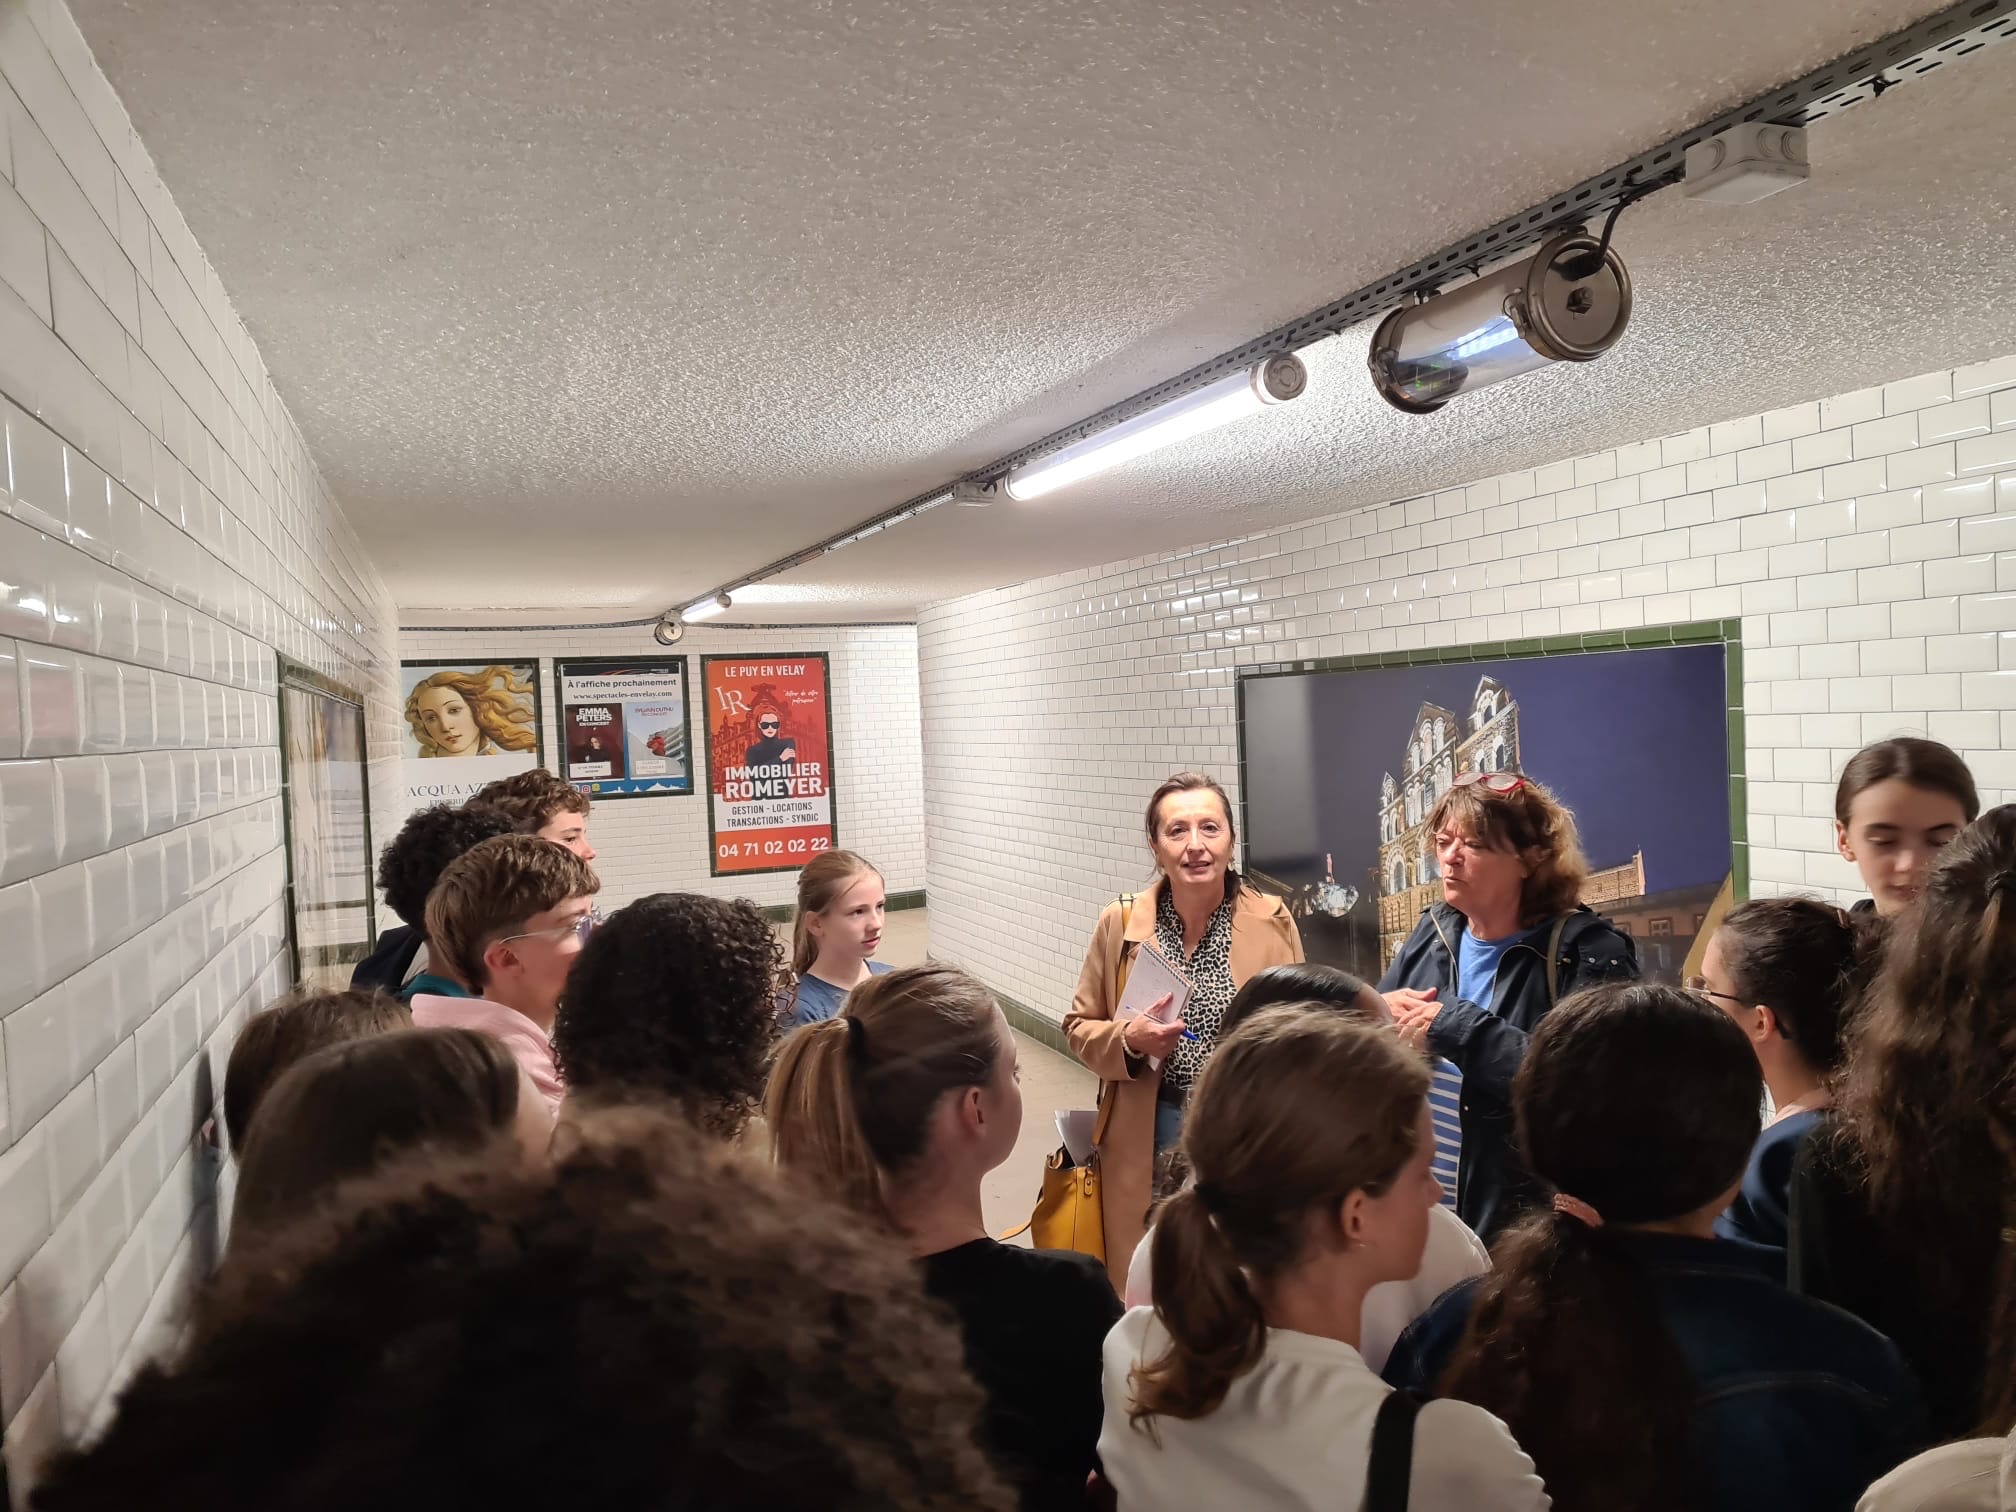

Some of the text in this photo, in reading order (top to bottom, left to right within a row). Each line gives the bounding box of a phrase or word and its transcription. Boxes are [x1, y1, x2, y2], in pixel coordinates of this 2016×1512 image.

[725, 665, 805, 677] LE PUY EN VELAY
[567, 679, 677, 688] À l'affiche prochainement
[576, 713, 612, 722] PETERS
[578, 707, 609, 715] EMMA
[725, 762, 821, 780] IMMOBILIER
[407, 784, 460, 798] ACQUA
[725, 777, 822, 799] ROMEYER
[732, 804, 764, 815] GESTION
[772, 802, 813, 813] LOCATIONS
[727, 815, 784, 828] TRANSACTIONS
[792, 813, 819, 823] SYNDIC
[719, 837, 829, 858] 04 71 02 02 22
